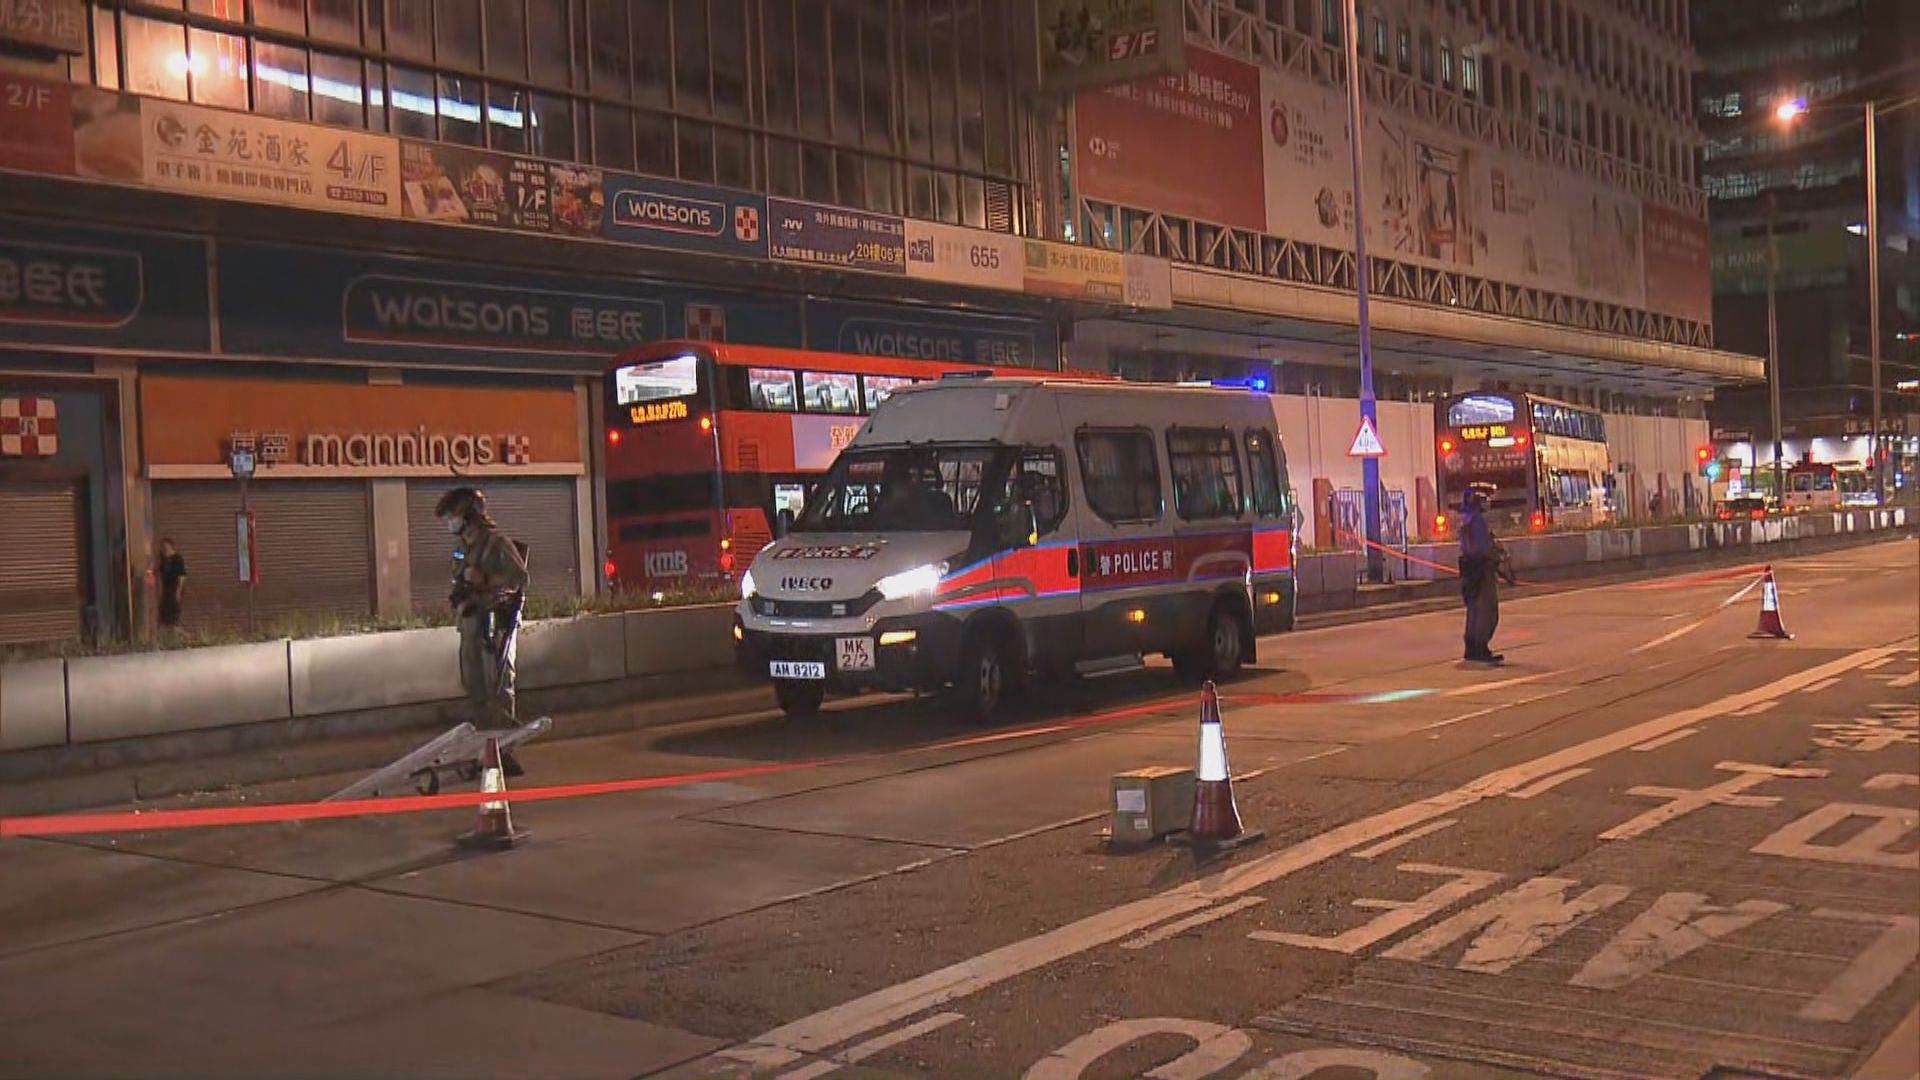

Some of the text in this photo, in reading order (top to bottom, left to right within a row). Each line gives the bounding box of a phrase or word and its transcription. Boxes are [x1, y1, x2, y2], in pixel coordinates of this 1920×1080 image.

[1110, 28, 1157, 60] 5/F
[6, 84, 52, 110] 2/F
[194, 122, 312, 168] 金苑酒家
[326, 139, 386, 185] 4/F
[627, 198, 712, 226] watsons
[970, 244, 1000, 270] 655
[1128, 281, 1152, 301] 655
[370, 290, 643, 341] watsons 屈臣氏
[854, 329, 963, 362] watsons
[306, 425, 494, 476] mannings
[643, 551, 689, 577] KMB
[1114, 550, 1159, 575] POLICE
[780, 576, 834, 591] IVECO
[844, 639, 865, 654] MK
[774, 663, 790, 676] AM
[842, 653, 870, 669] 2/2
